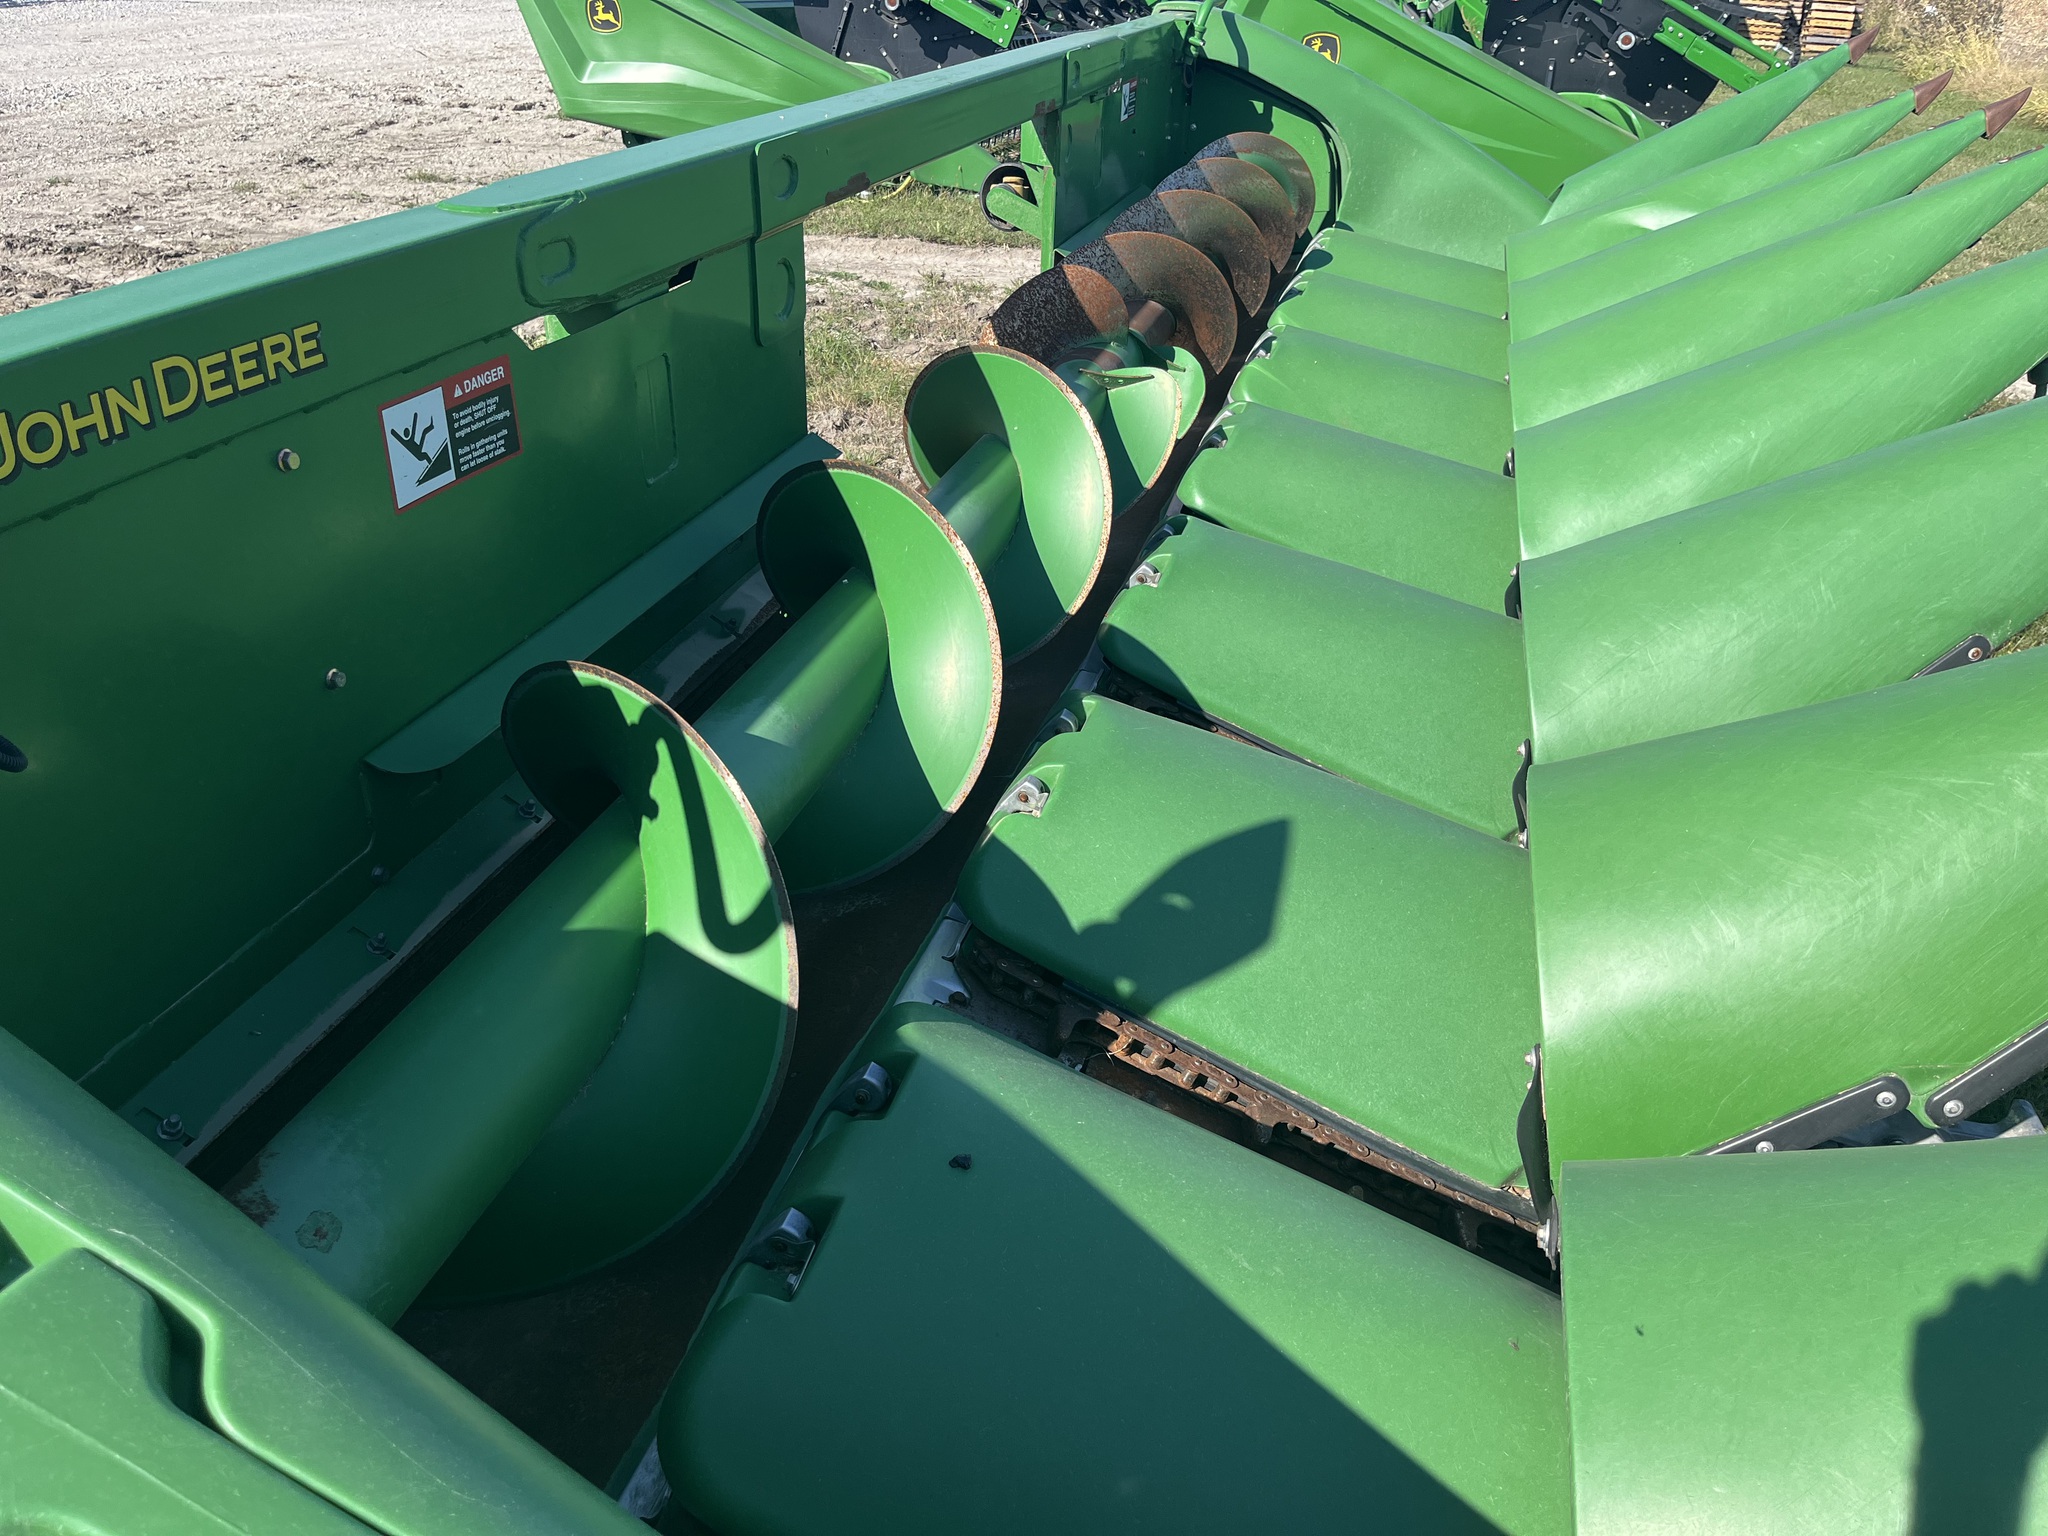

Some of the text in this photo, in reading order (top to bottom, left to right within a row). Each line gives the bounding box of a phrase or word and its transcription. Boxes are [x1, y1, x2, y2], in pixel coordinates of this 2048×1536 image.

[463, 366, 505, 393] DANGER
[0, 321, 327, 483] JOHN DEERE
[452, 395, 499, 420] To avoid bodily injury
[460, 415, 474, 426] death,
[473, 408, 487, 419] SHUT
[487, 403, 496, 413] OFF
[455, 409, 511, 438] engine before unclogging.
[458, 446, 470, 456] Rolls
[475, 434, 497, 449] gathering
[497, 429, 508, 438] units
[459, 439, 505, 464] move faster than you
[461, 463, 470, 472] can
[476, 454, 489, 464] loose
[489, 451, 494, 459] of
[494, 446, 506, 456] stalk.
